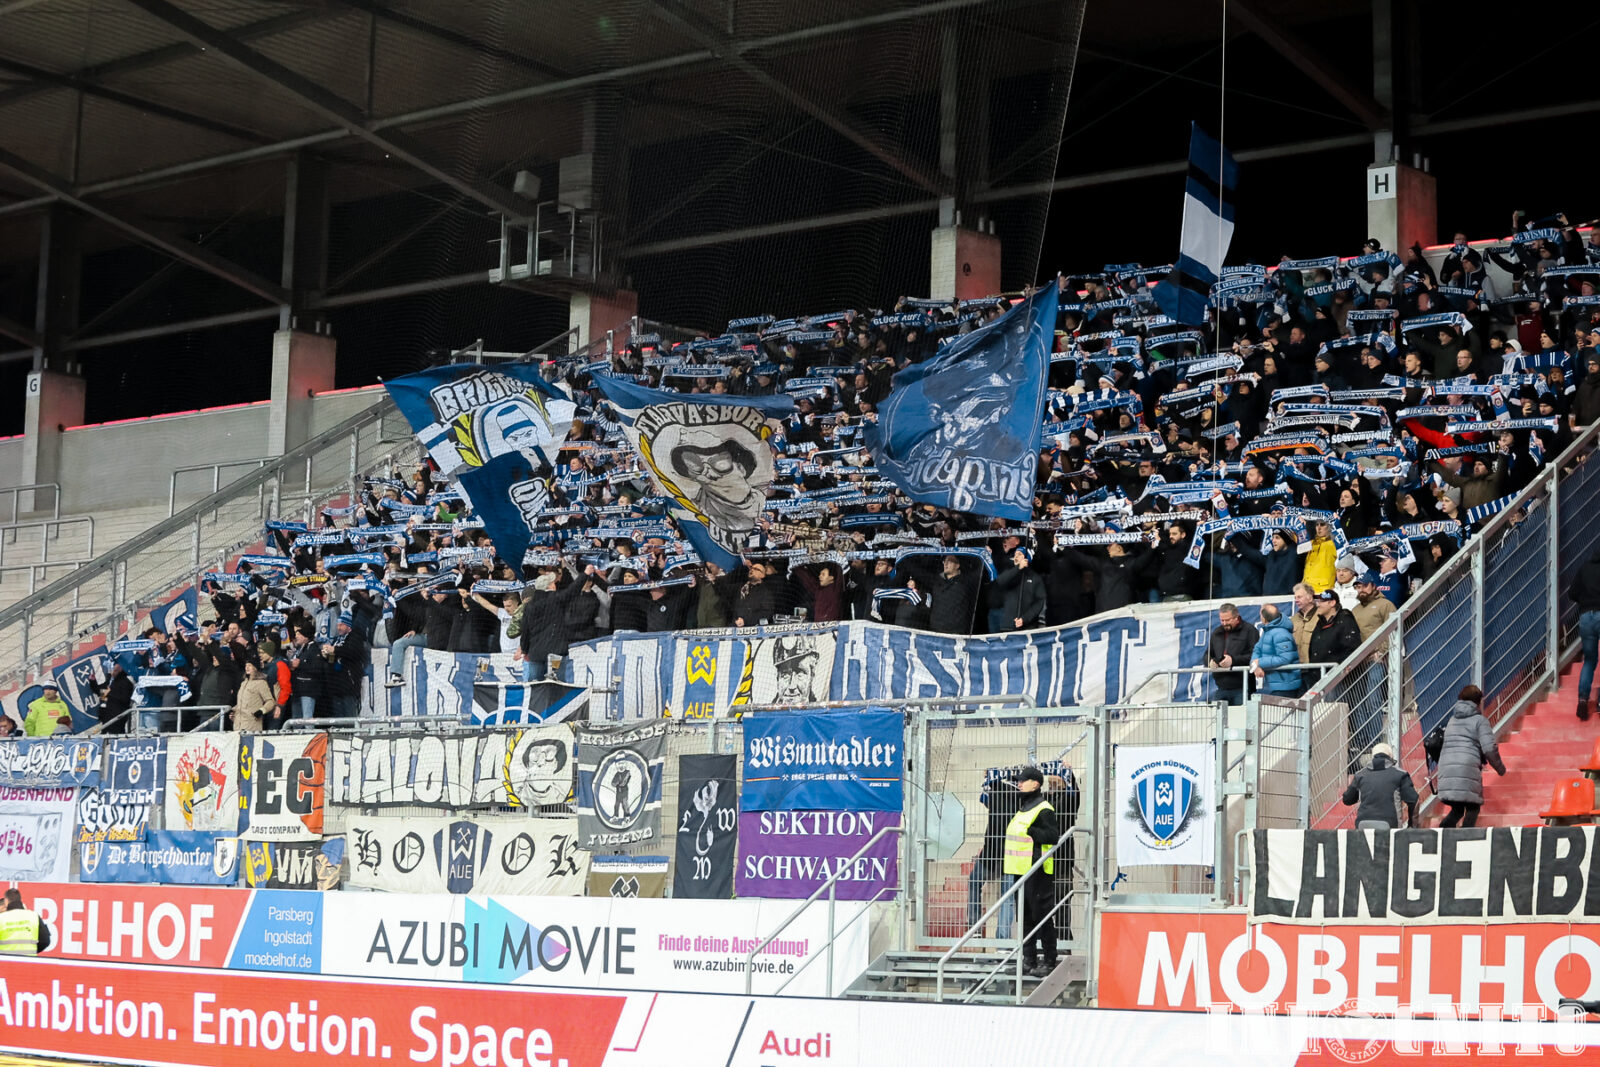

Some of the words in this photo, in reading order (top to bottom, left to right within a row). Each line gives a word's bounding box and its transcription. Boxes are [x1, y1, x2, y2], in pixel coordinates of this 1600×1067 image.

[1375, 173, 1389, 194] H
[1220, 266, 1252, 275] ZGEBIRGE
[30, 378, 37, 392] G
[1260, 438, 1301, 448] ERZGEBIRGE
[1438, 443, 1488, 456] WISMUT
[684, 702, 714, 718] AUE
[580, 723, 667, 747] BRIGADE
[749, 735, 896, 768] Wismutadler
[1130, 760, 1161, 780] SEKTION
[1163, 759, 1199, 778] SÜDWEST
[255, 758, 314, 814] EC
[760, 811, 876, 836] SEKTION
[1155, 814, 1173, 825] AUE
[269, 825, 301, 835] COMPANY
[588, 828, 654, 847] JUGEND
[107, 846, 131, 865] De
[450, 866, 472, 880] AUE
[745, 855, 889, 881] SCHWABEN
[268, 906, 314, 925] Parsberg
[33, 896, 214, 961] BELHOF
[264, 929, 313, 946] Ingolstadt
[366, 919, 479, 968] AZUBI
[498, 922, 637, 975] MOVIE
[658, 934, 691, 952] Finde
[694, 936, 729, 953] deine
[244, 951, 313, 968] moebelhof.de
[673, 958, 794, 974] www.azubimovie.de
[0, 976, 177, 1041] Ambition.
[193, 991, 392, 1059] Emotion.
[409, 1005, 569, 1067] Space.
[759, 1030, 831, 1058] Audi
